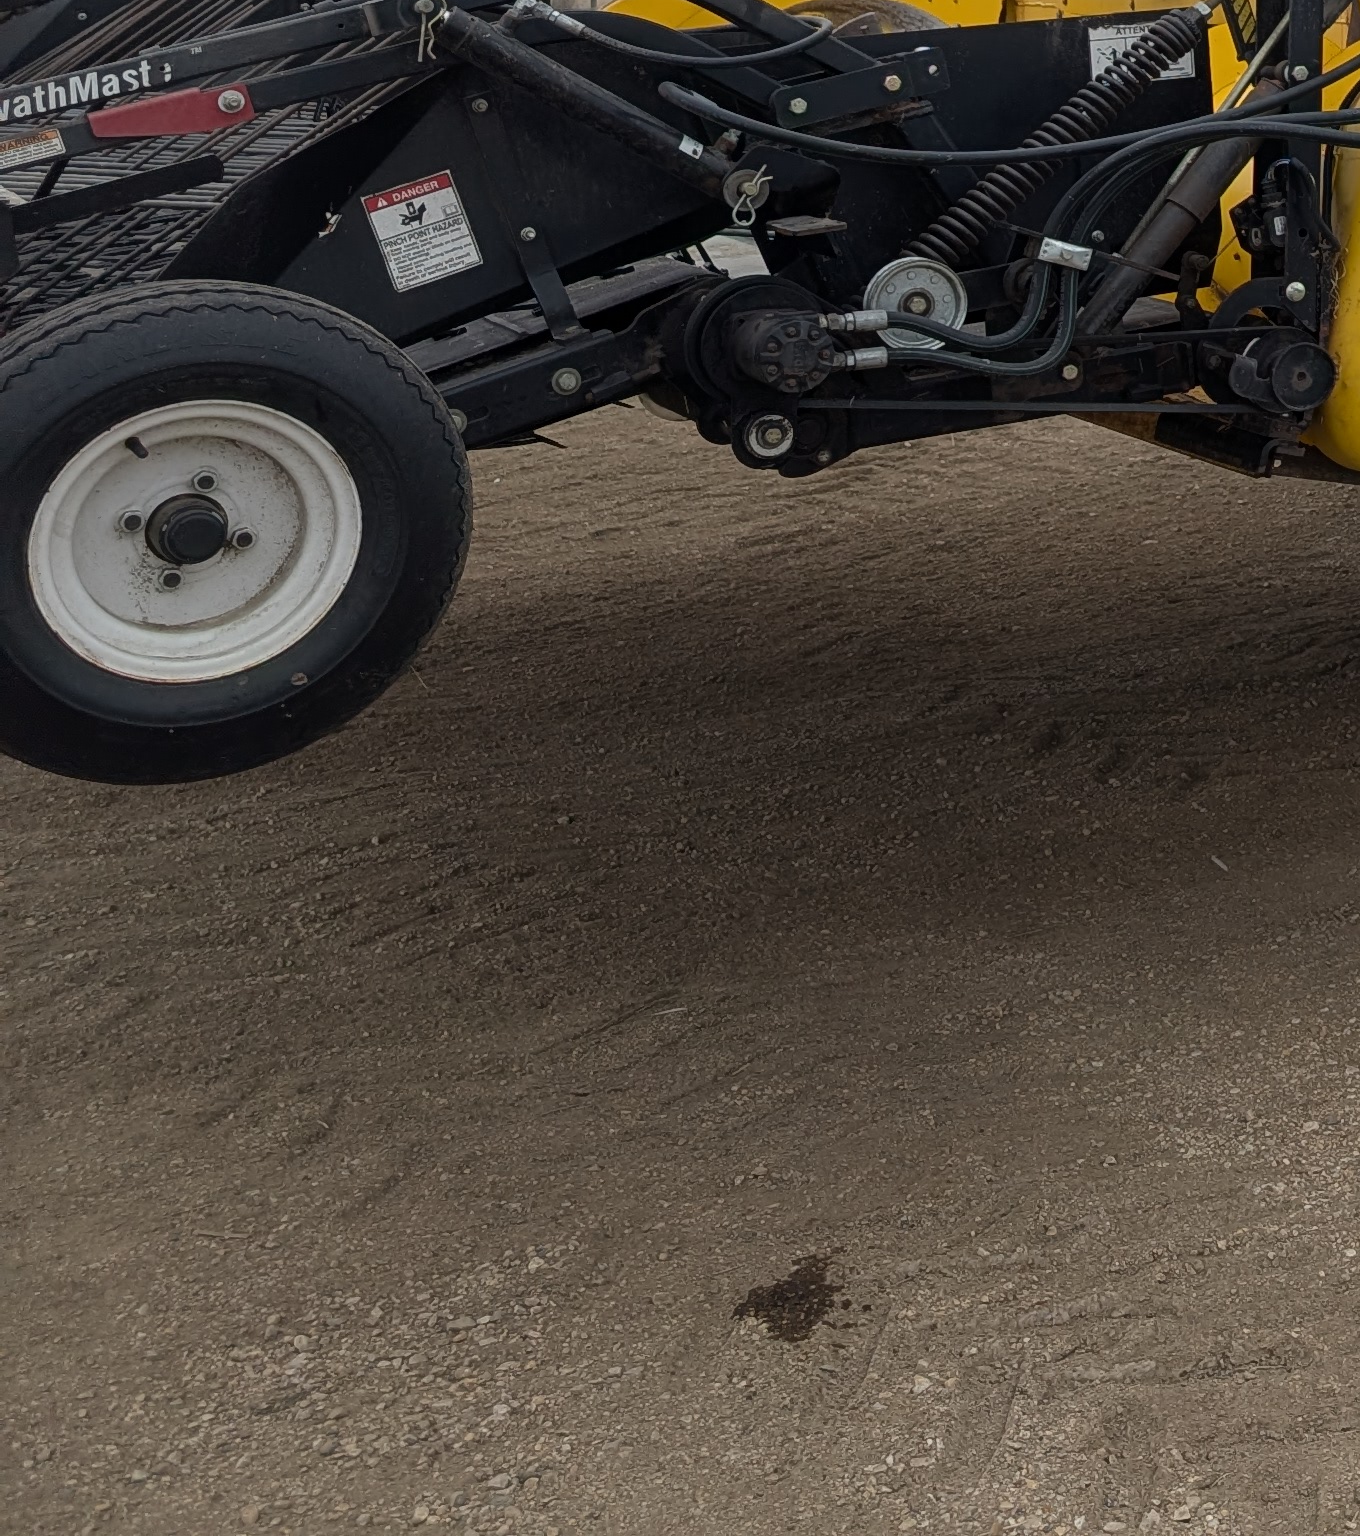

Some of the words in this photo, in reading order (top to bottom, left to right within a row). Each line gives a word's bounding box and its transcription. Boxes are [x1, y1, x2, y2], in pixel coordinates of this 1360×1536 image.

[1115, 25, 1152, 36] ATTENT
[392, 181, 439, 202] DANGER
[383, 238, 407, 249] PINCH
[408, 229, 431, 241] POINT
[432, 218, 463, 233] HAZARD
